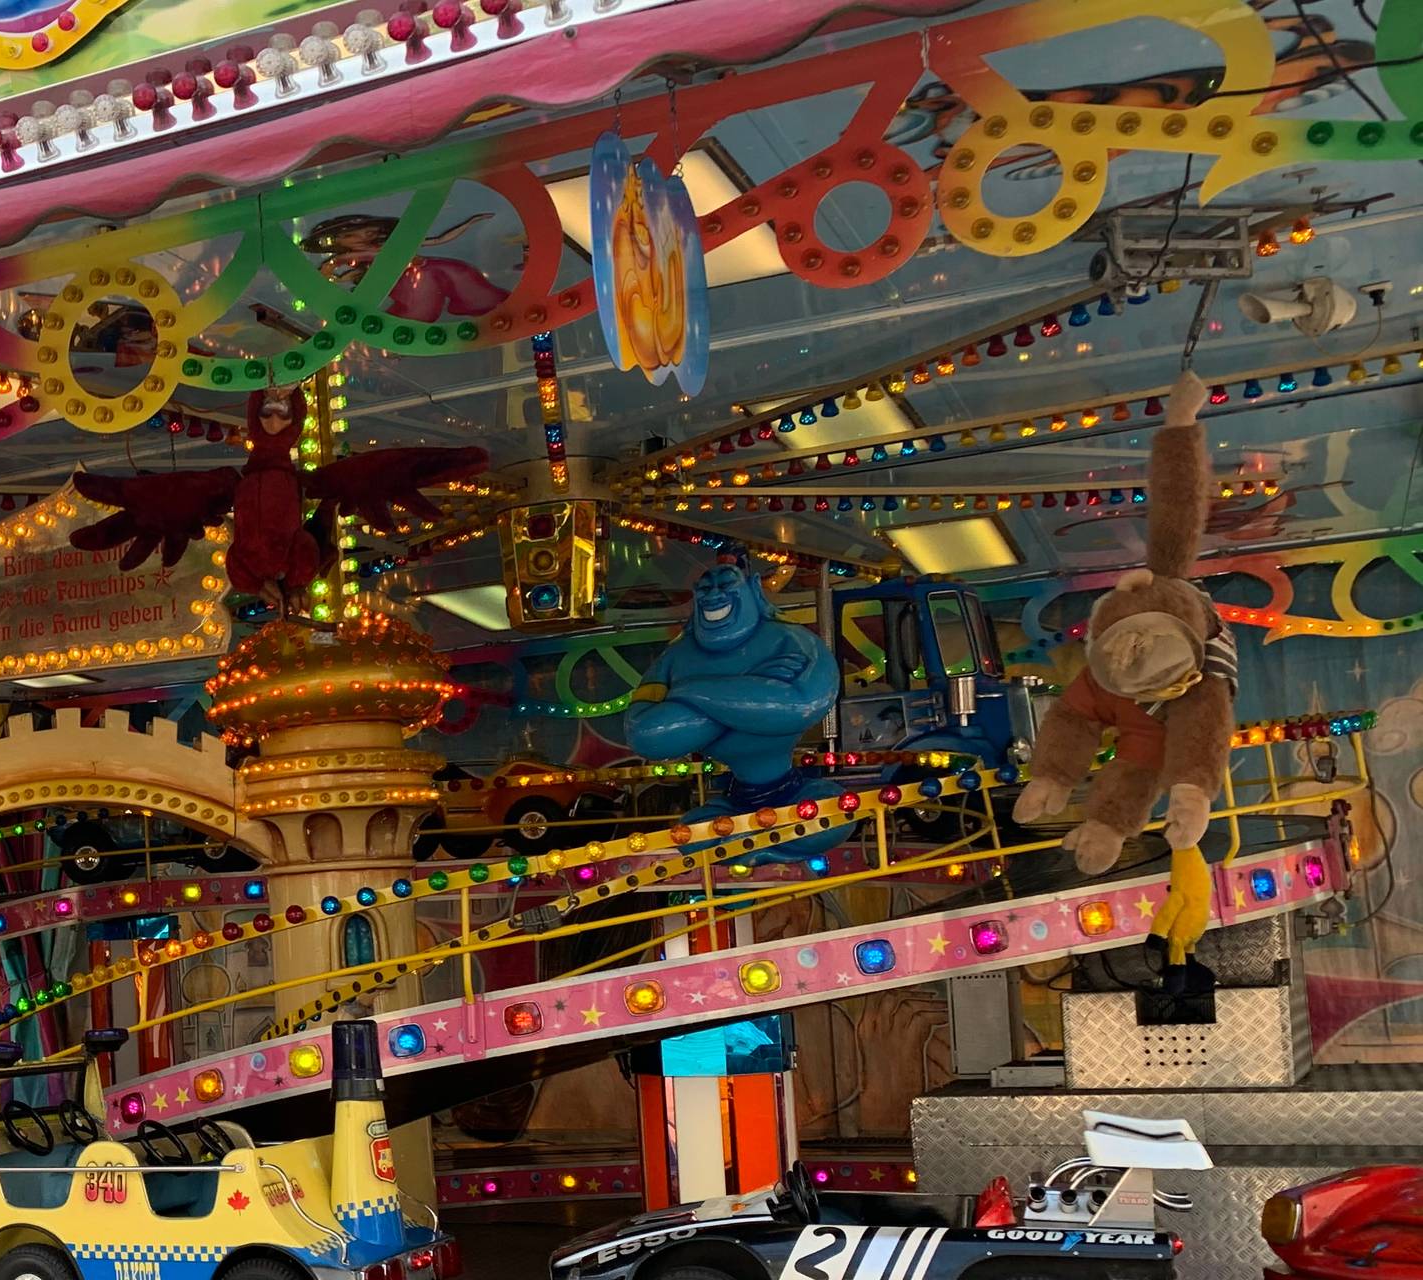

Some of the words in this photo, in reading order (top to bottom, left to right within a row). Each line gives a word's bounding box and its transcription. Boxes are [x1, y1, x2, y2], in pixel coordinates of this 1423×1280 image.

[4, 553, 45, 577] Bitte
[53, 550, 83, 569] den
[23, 585, 49, 605] die
[57, 573, 146, 601] Fahrchips
[19, 618, 45, 638] die
[52, 611, 101, 634] Hand
[109, 602, 163, 632] geben
[85, 1161, 127, 1204] 340
[597, 1227, 697, 1265] ESSO
[794, 1226, 848, 1280] 2
[987, 1229, 1064, 1242] GOOD
[1085, 1231, 1155, 1245] YEAR
[114, 1261, 161, 1280] DAKOTA
